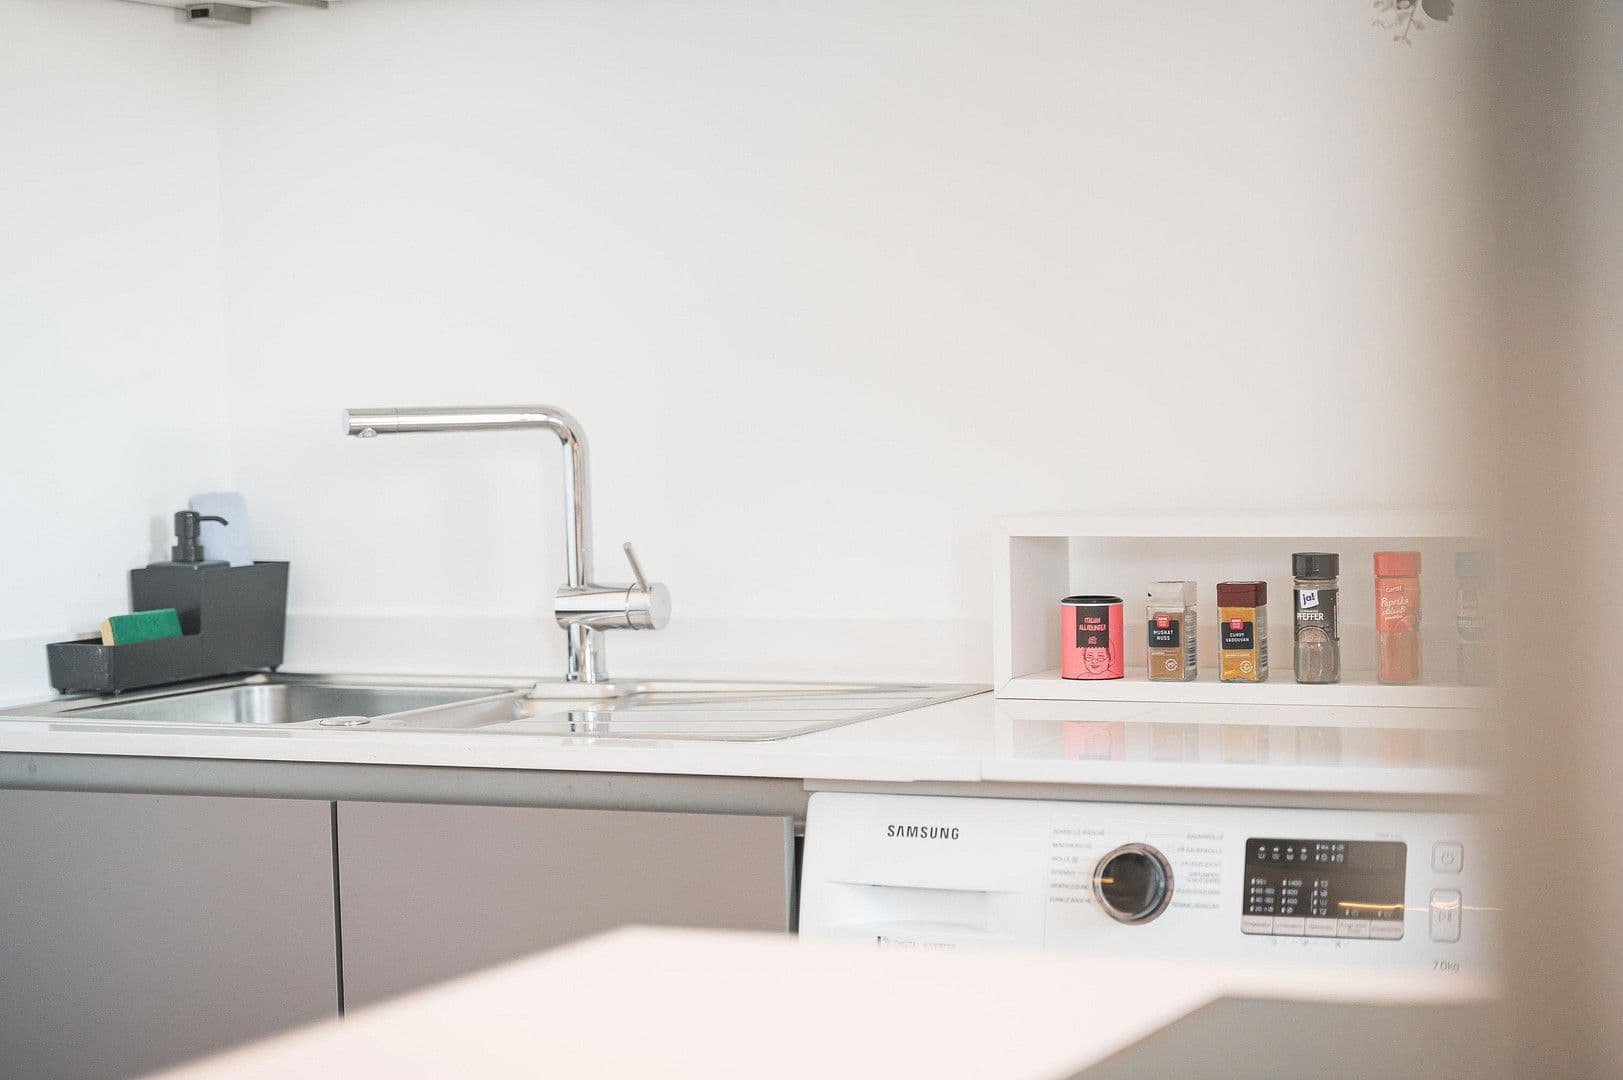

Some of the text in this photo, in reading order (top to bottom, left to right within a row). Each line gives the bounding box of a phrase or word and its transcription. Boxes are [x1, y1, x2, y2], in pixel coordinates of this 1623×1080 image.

[1302, 592, 1315, 605] ja!
[1296, 612, 1324, 621] PFEFFER
[887, 824, 960, 840] SAMSUNG
